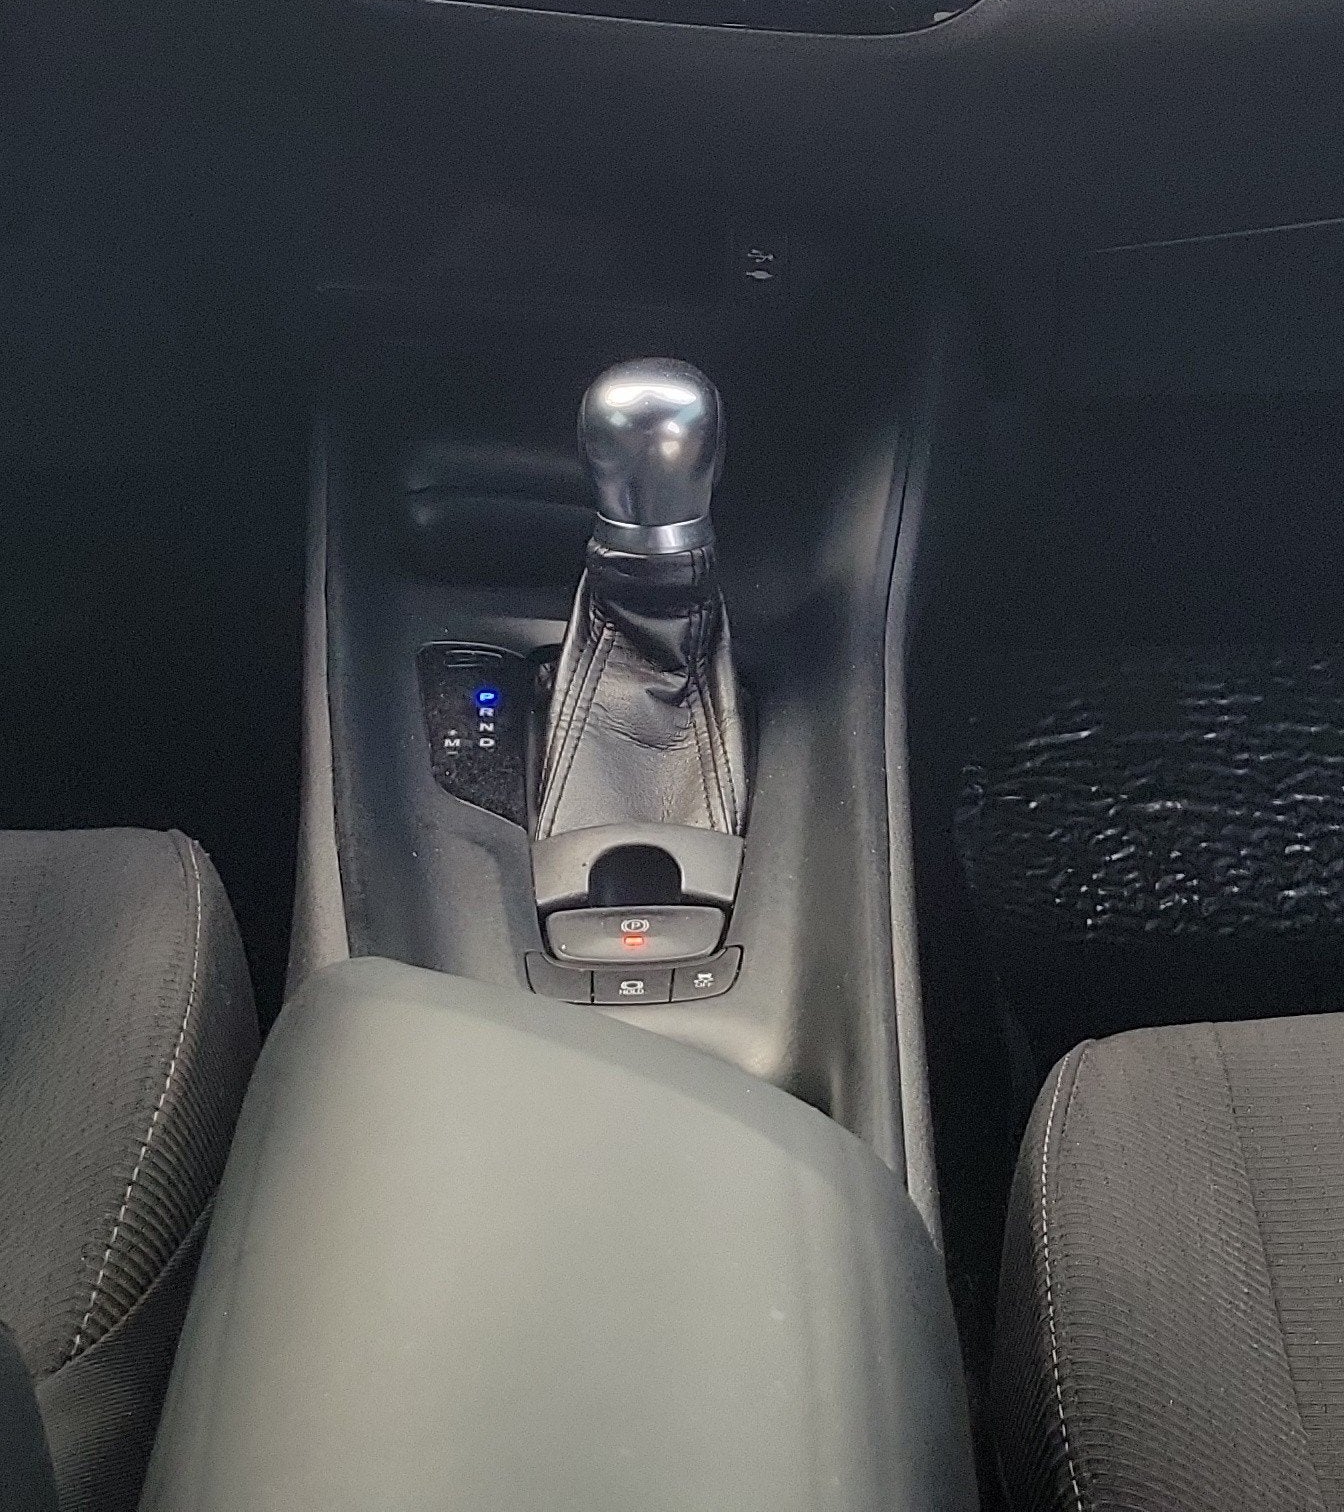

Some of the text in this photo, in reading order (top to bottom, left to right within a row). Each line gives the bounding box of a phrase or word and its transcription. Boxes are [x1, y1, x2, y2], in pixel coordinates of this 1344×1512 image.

[479, 693, 495, 701] P
[479, 708, 495, 716] R
[479, 723, 495, 731] N
[444, 738, 460, 747] M
[479, 738, 495, 746] D
